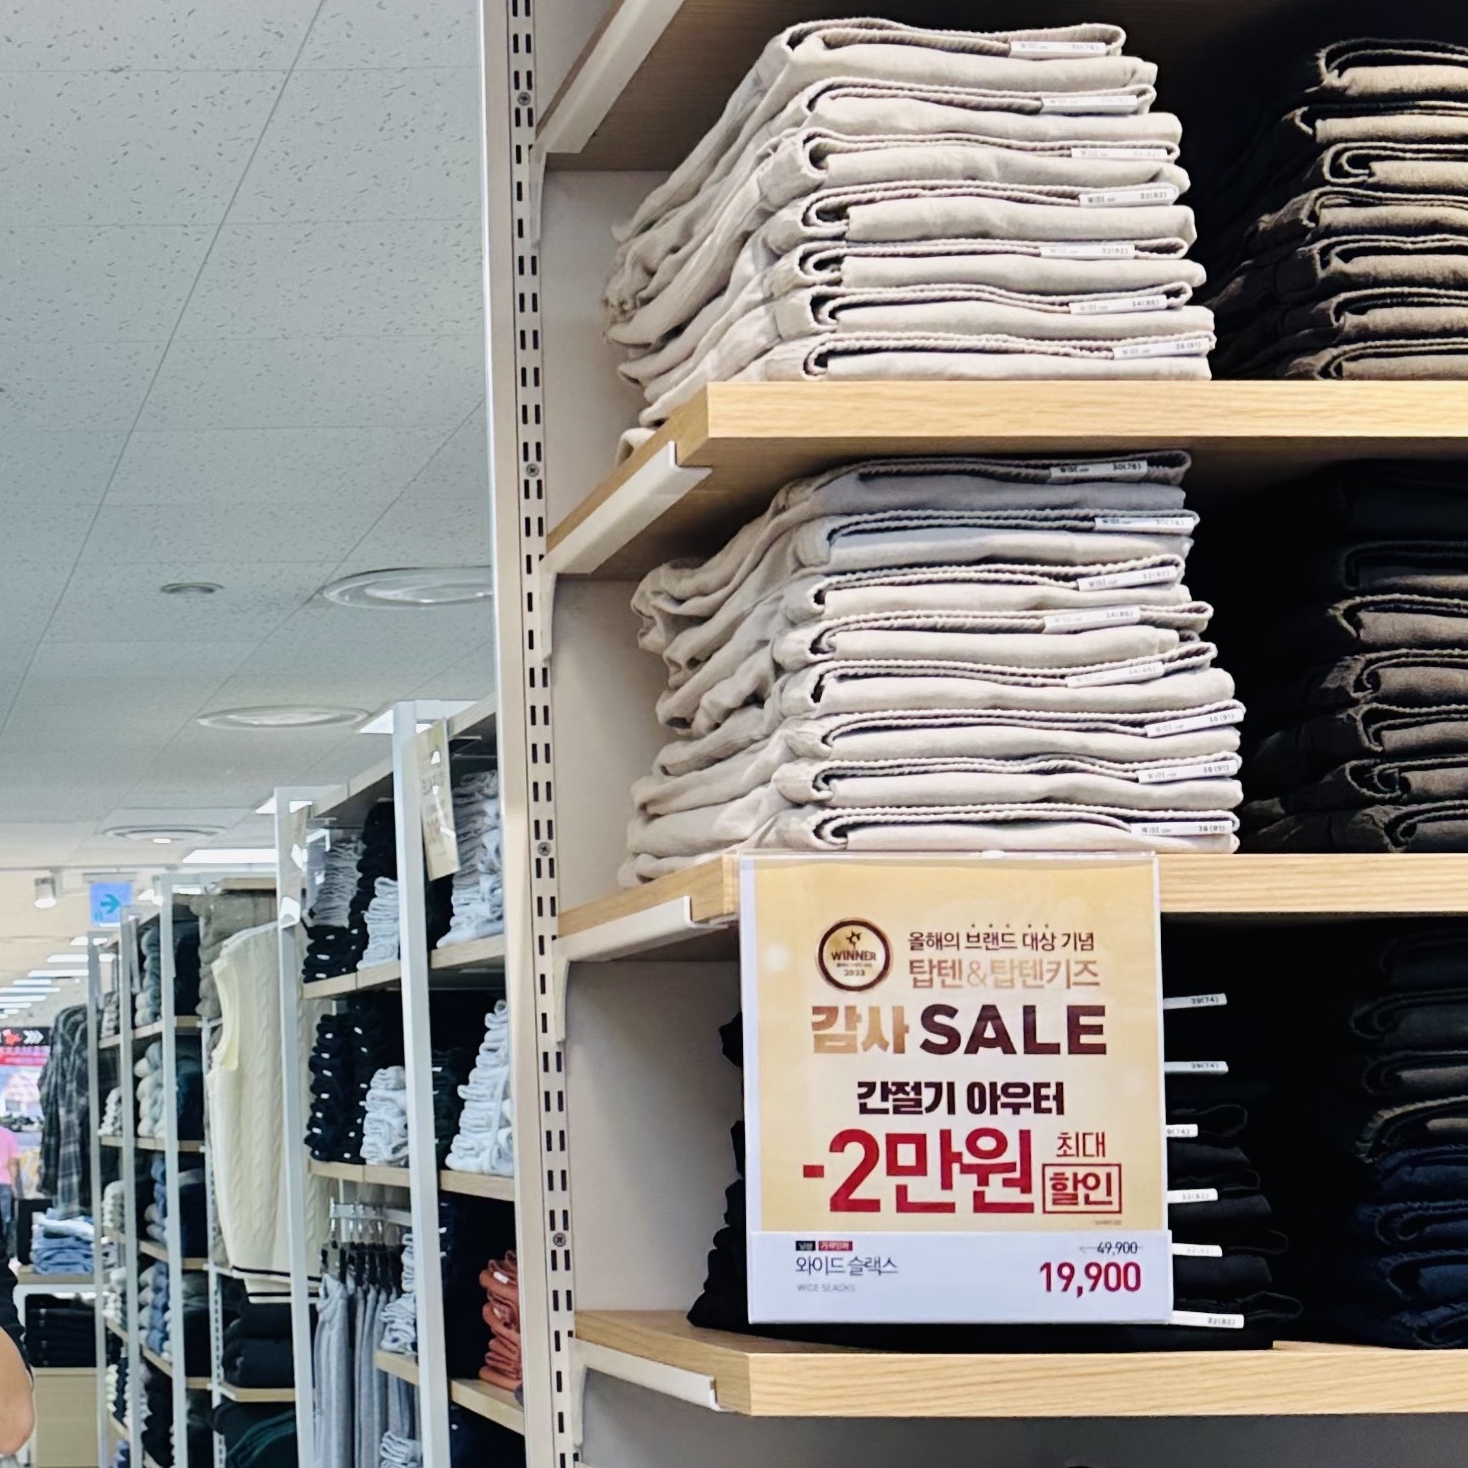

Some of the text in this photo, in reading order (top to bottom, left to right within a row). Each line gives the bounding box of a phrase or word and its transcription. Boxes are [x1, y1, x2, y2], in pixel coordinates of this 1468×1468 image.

[831, 950, 877, 961] WINNER
[908, 931, 1095, 951] 올해의 브랜드 대상 기념
[908, 957, 1101, 990] 탑텐&탑텐키즈
[810, 1003, 1107, 1056] 감사 SALE
[857, 1081, 1065, 1116] 간절기 아우터
[1056, 1131, 1106, 1159] 최대
[802, 1127, 1035, 1215] -2만원
[1049, 1170, 1114, 1207] 할인
[1096, 1241, 1138, 1256] 49,900
[795, 1255, 899, 1276] 와이드 슬랙스
[1039, 1261, 1142, 1299] 19,900
